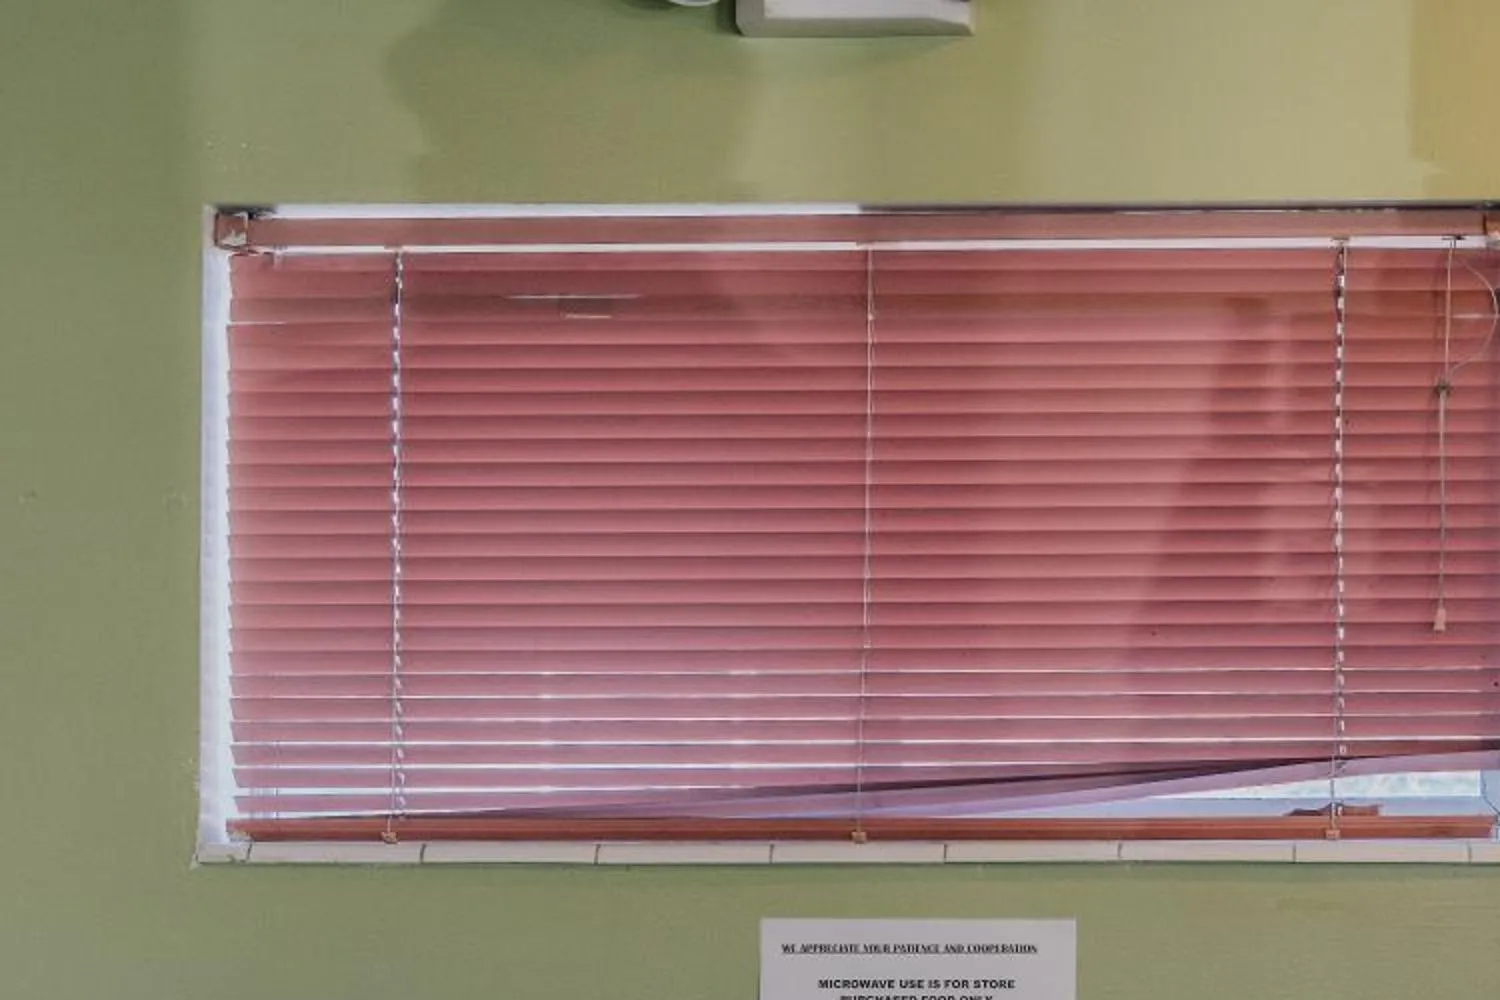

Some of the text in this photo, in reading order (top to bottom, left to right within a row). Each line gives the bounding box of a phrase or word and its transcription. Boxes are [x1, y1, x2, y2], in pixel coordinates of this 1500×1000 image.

[781, 943, 1038, 954] WE APPRECIATE YOUR PATIENCE AND COOPERATION
[817, 978, 1015, 990] MICROWAVE USE IS FOR STORE
